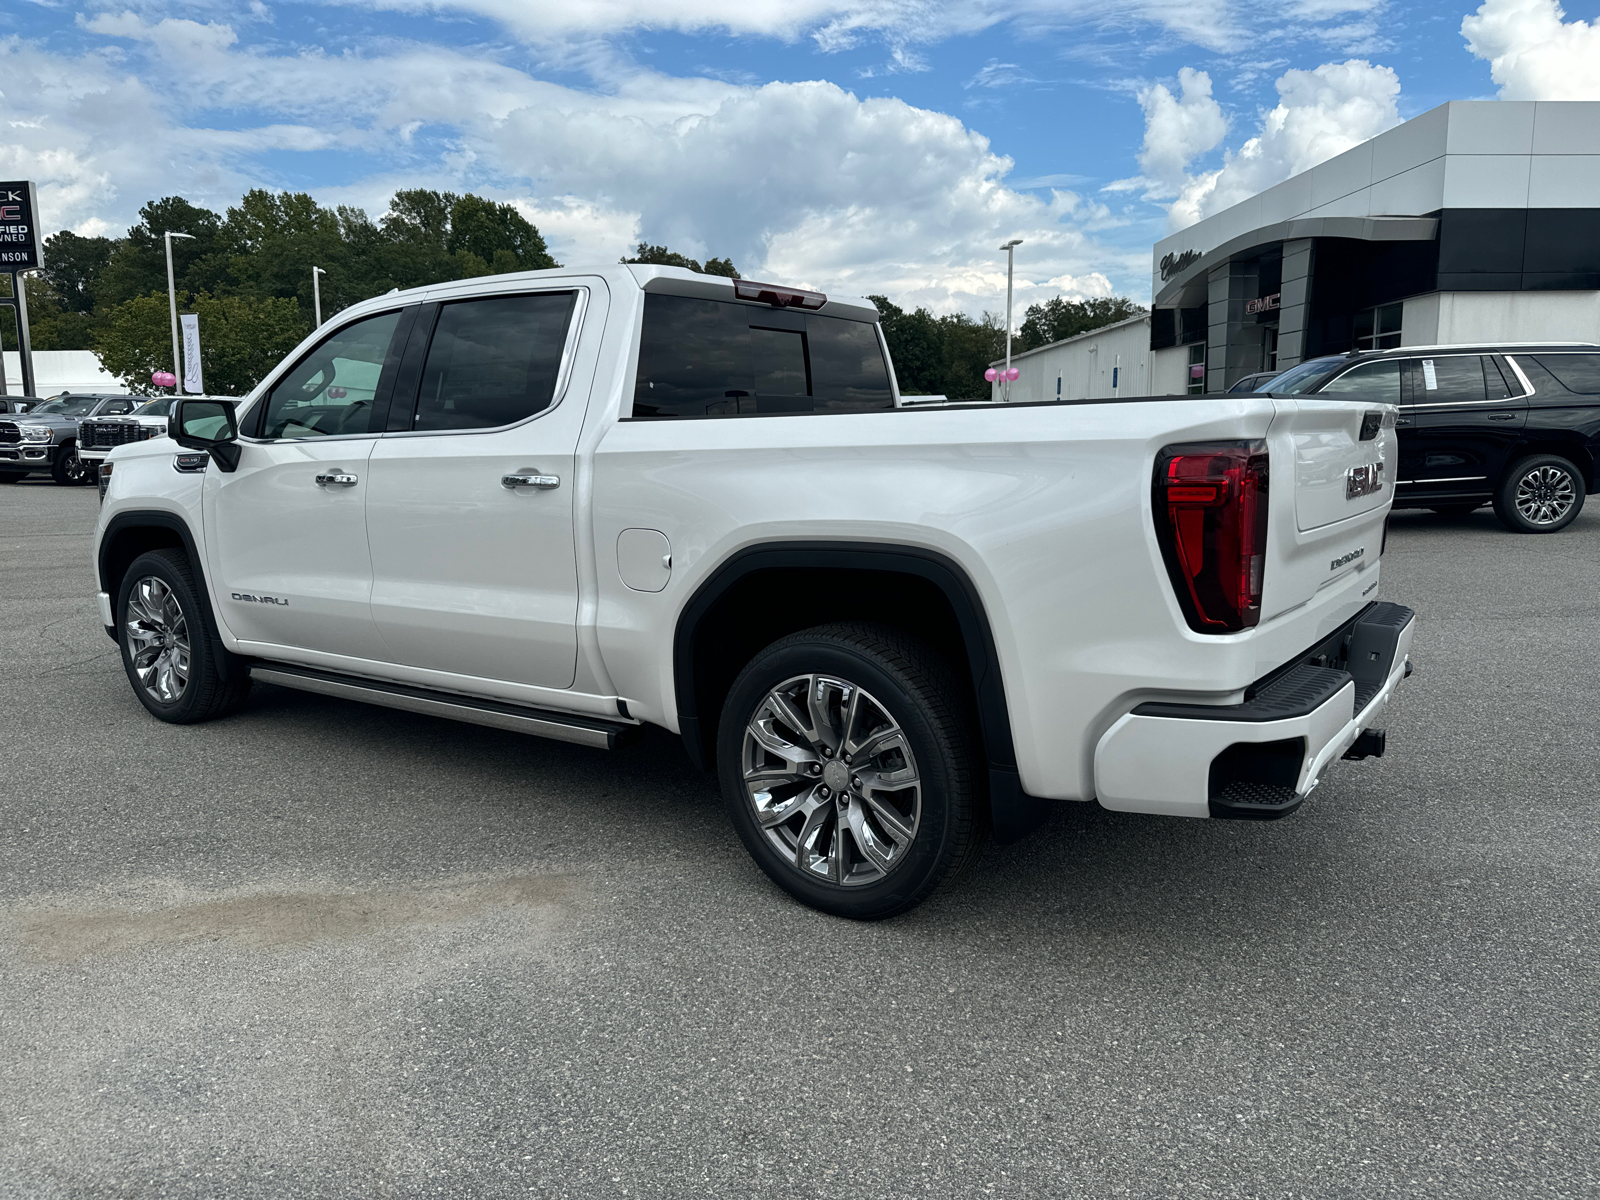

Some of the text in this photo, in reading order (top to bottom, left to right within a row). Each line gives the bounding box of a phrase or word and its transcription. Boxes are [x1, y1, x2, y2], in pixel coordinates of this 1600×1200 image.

[0, 205, 21, 220] C
[1245, 292, 1281, 315] GMC
[1345, 462, 1384, 501] GMC
[231, 592, 290, 607] DENALI
